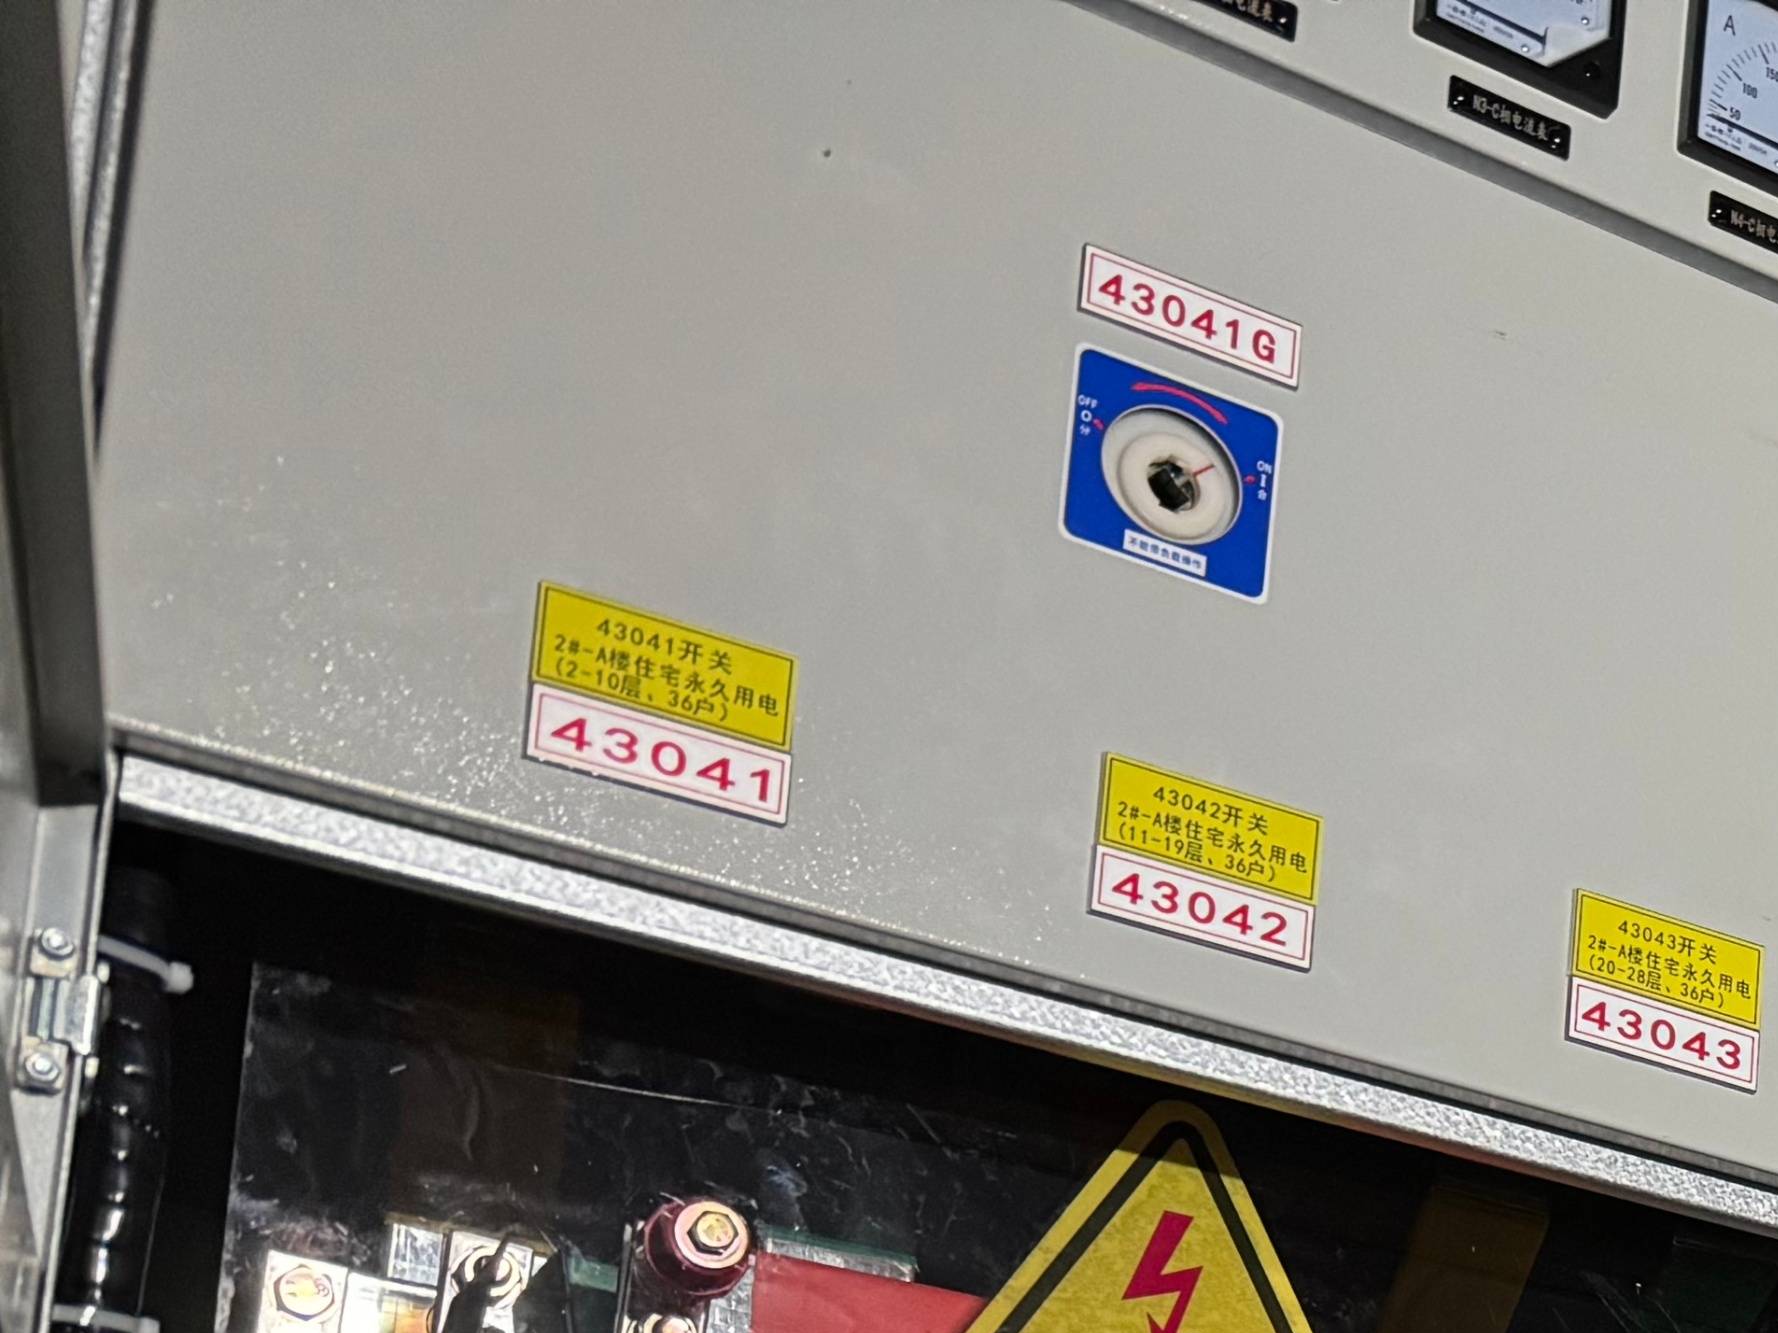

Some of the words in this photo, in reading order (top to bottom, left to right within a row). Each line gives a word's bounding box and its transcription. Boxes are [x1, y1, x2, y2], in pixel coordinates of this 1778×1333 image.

[1723, 15, 1736, 35] A
[1729, 107, 1742, 121] 50
[1742, 82, 1758, 100] 100
[1099, 274, 1277, 364] 43041G
[554, 634, 780, 717] 2#-A楼住宅永久用电
[596, 618, 733, 677] 43041开关
[550, 717, 772, 802] 43041
[1117, 801, 1308, 874] 2#-A楼住宅永久用电
[1153, 787, 1269, 836] 43042开关
[1111, 872, 1288, 947] 43042
[1588, 935, 1751, 1000] 2#-A楼住宅永久用电
[1618, 920, 1717, 965] 43043开关
[1582, 1001, 1741, 1070] 43043
